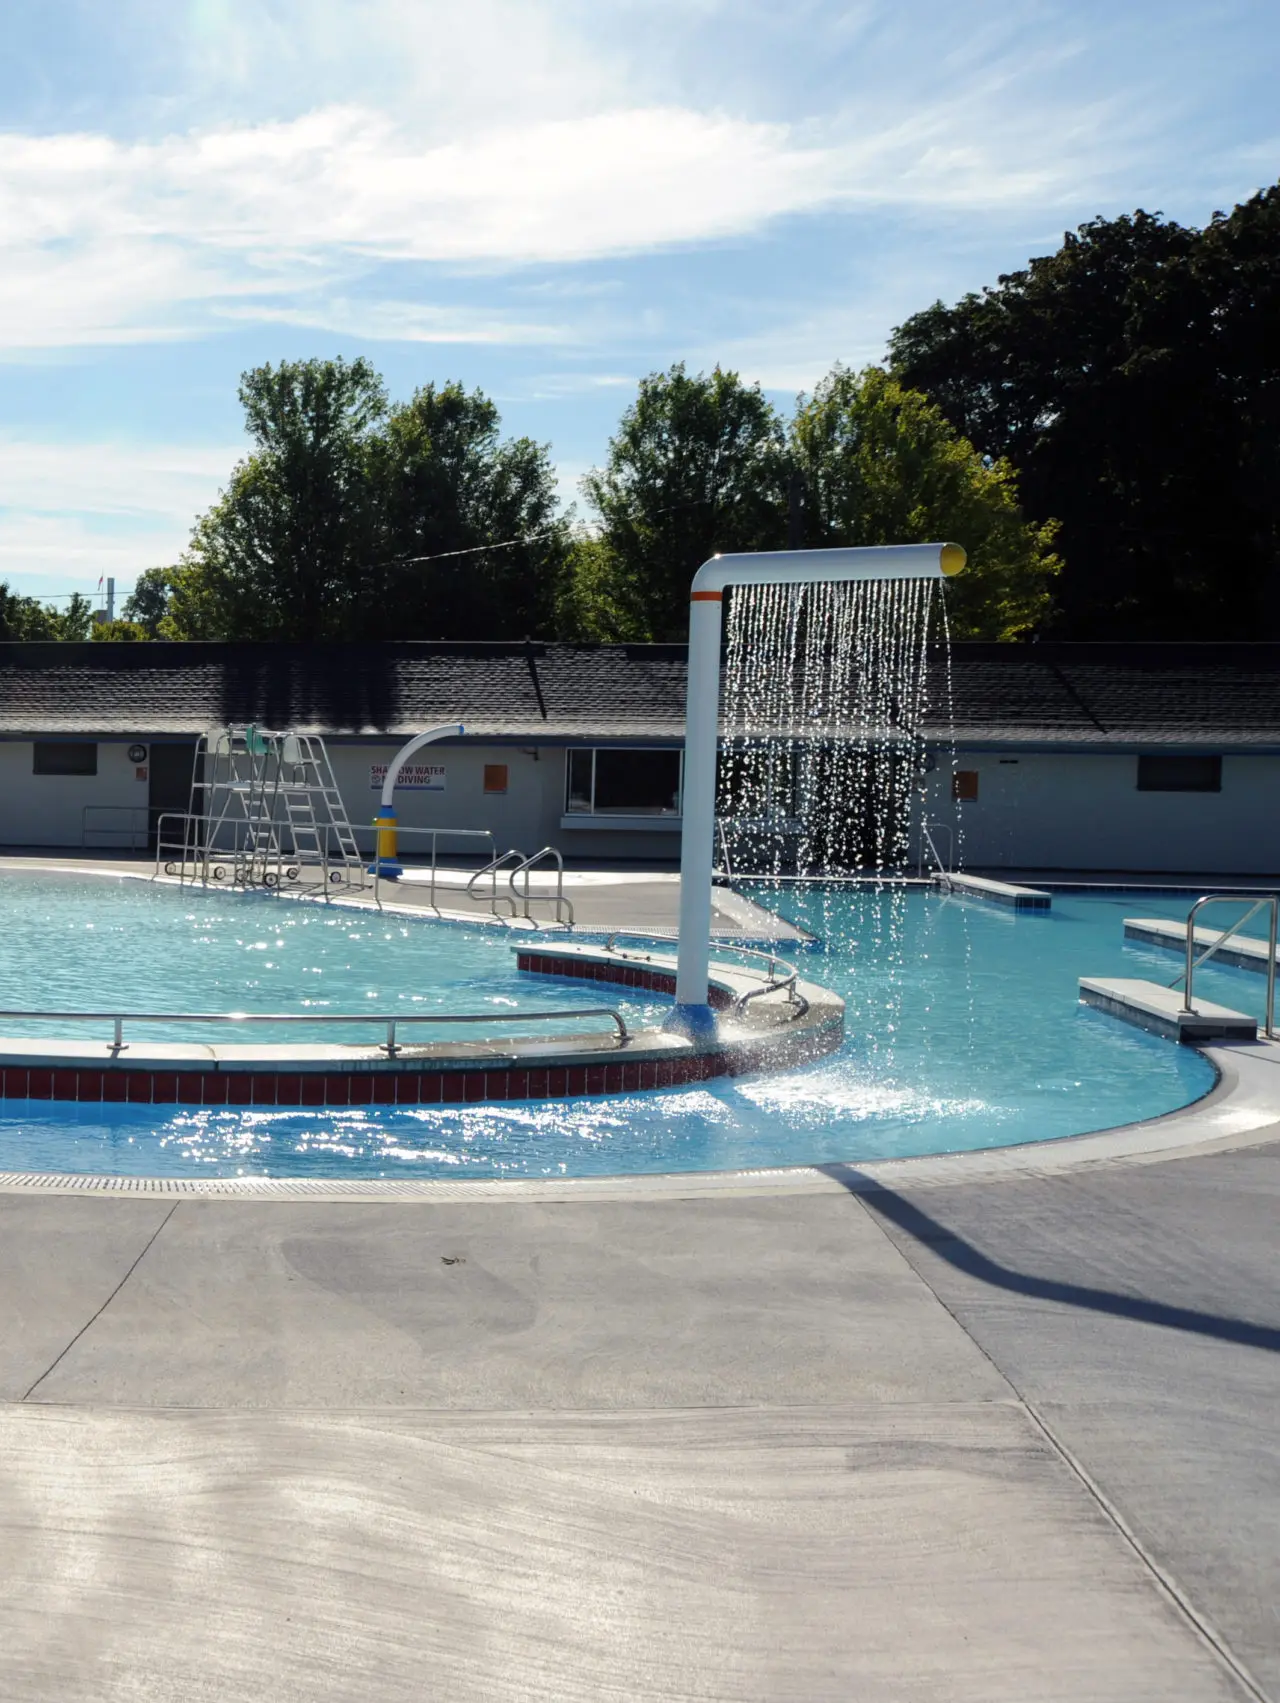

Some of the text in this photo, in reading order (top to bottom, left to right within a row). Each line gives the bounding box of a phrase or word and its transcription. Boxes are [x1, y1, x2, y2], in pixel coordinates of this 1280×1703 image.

[371, 765, 445, 775] SHAOW WATER
[398, 775, 431, 784] DIVING
